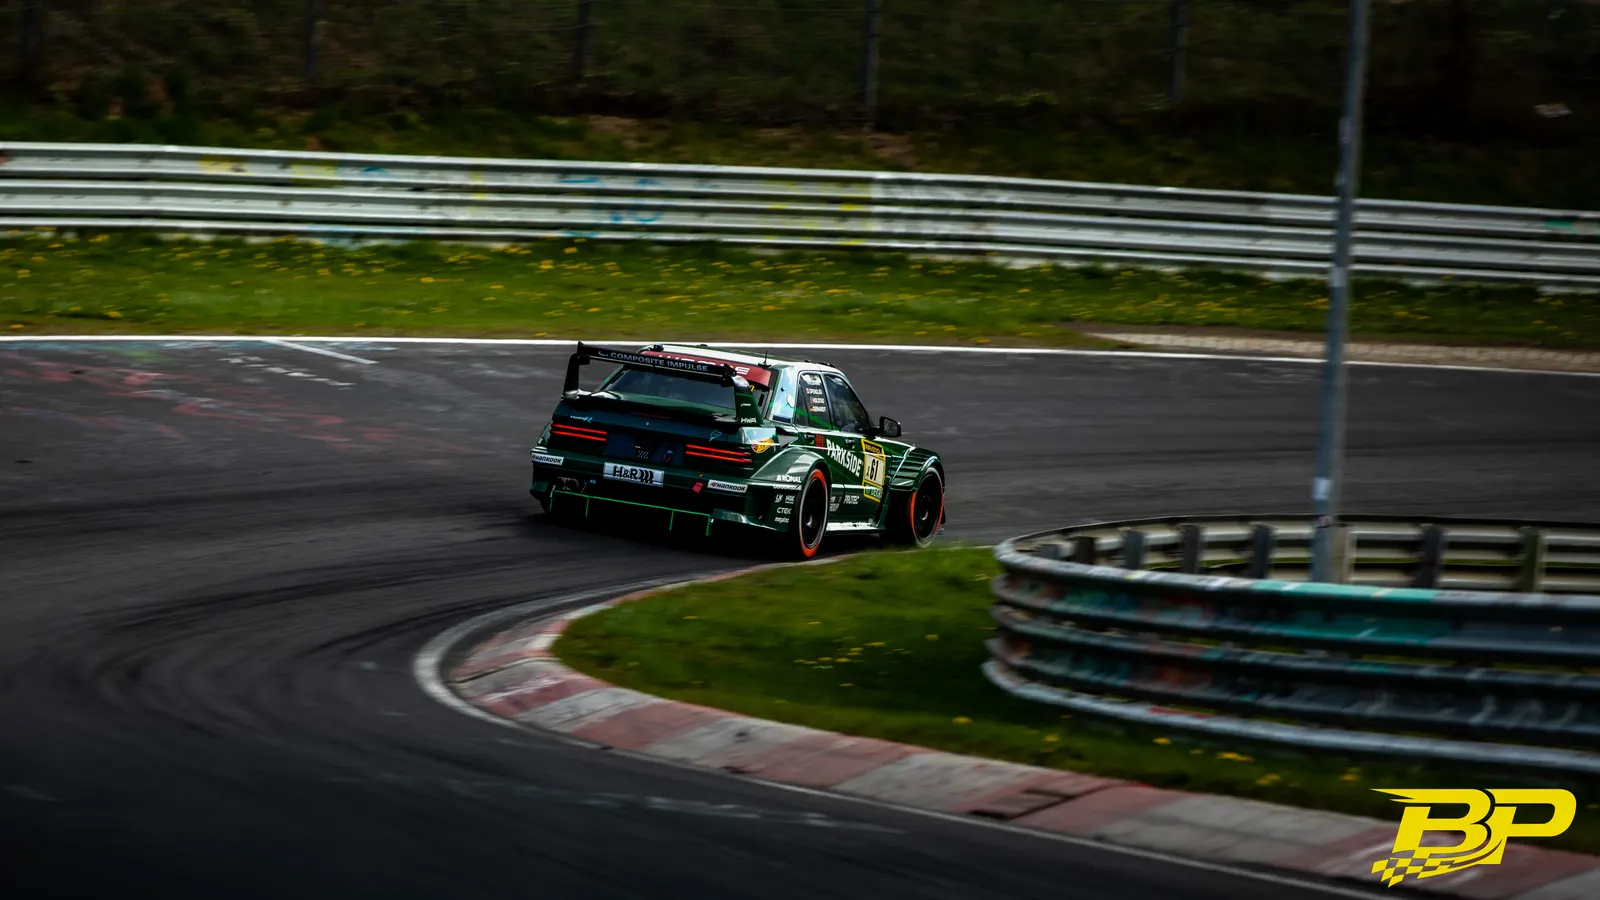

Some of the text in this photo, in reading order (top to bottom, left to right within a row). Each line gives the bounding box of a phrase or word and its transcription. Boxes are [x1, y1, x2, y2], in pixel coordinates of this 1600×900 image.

[610, 352, 665, 366] COMPOSITE
[667, 360, 708, 371] IMPULSE
[826, 439, 862, 478] PARKSIDE
[870, 458, 879, 482] 61
